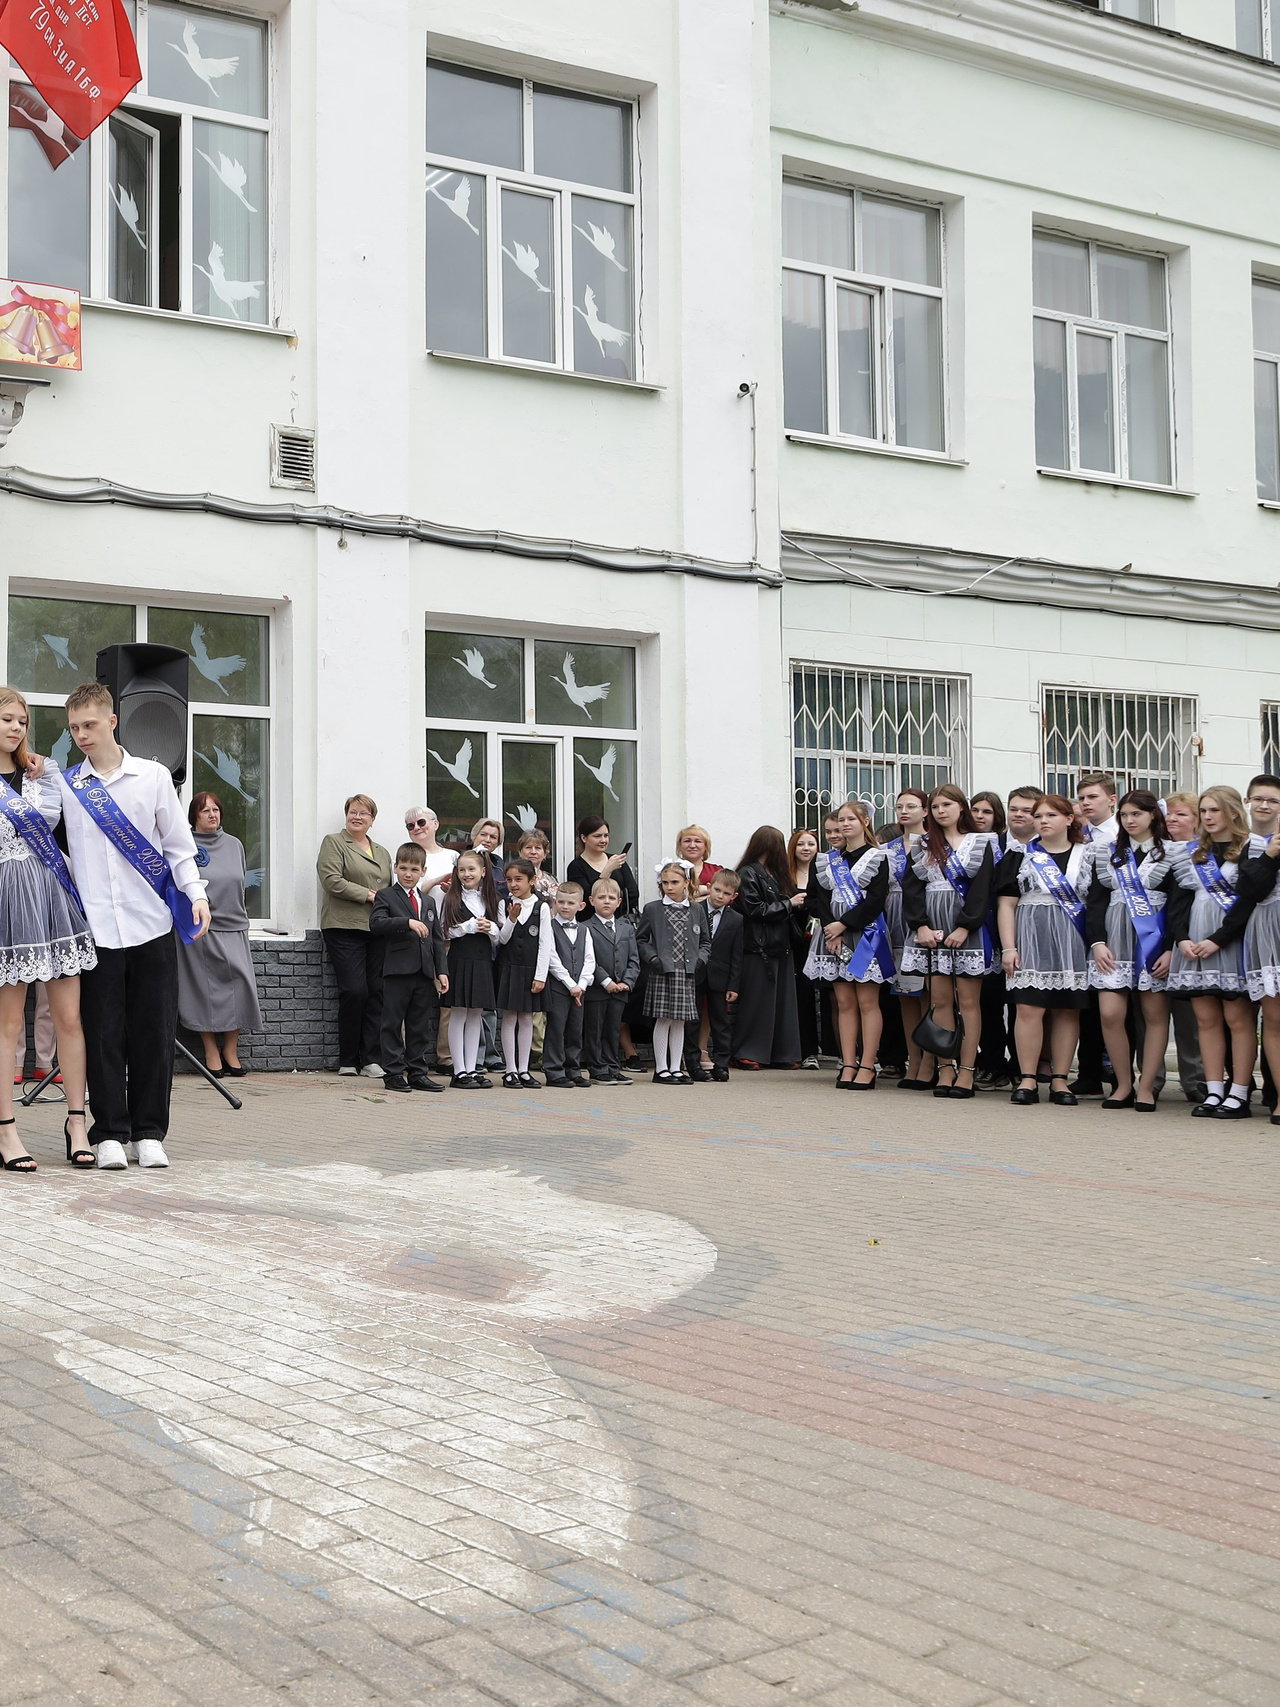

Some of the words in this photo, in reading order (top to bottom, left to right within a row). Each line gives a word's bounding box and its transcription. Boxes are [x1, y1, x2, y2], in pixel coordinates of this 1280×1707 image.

[29, 0, 51, 31] 79
[6, 797, 55, 859] Выпускница
[86, 787, 137, 850] Выпускник
[136, 848, 168, 876] 2025
[1131, 895, 1152, 917] 2025
